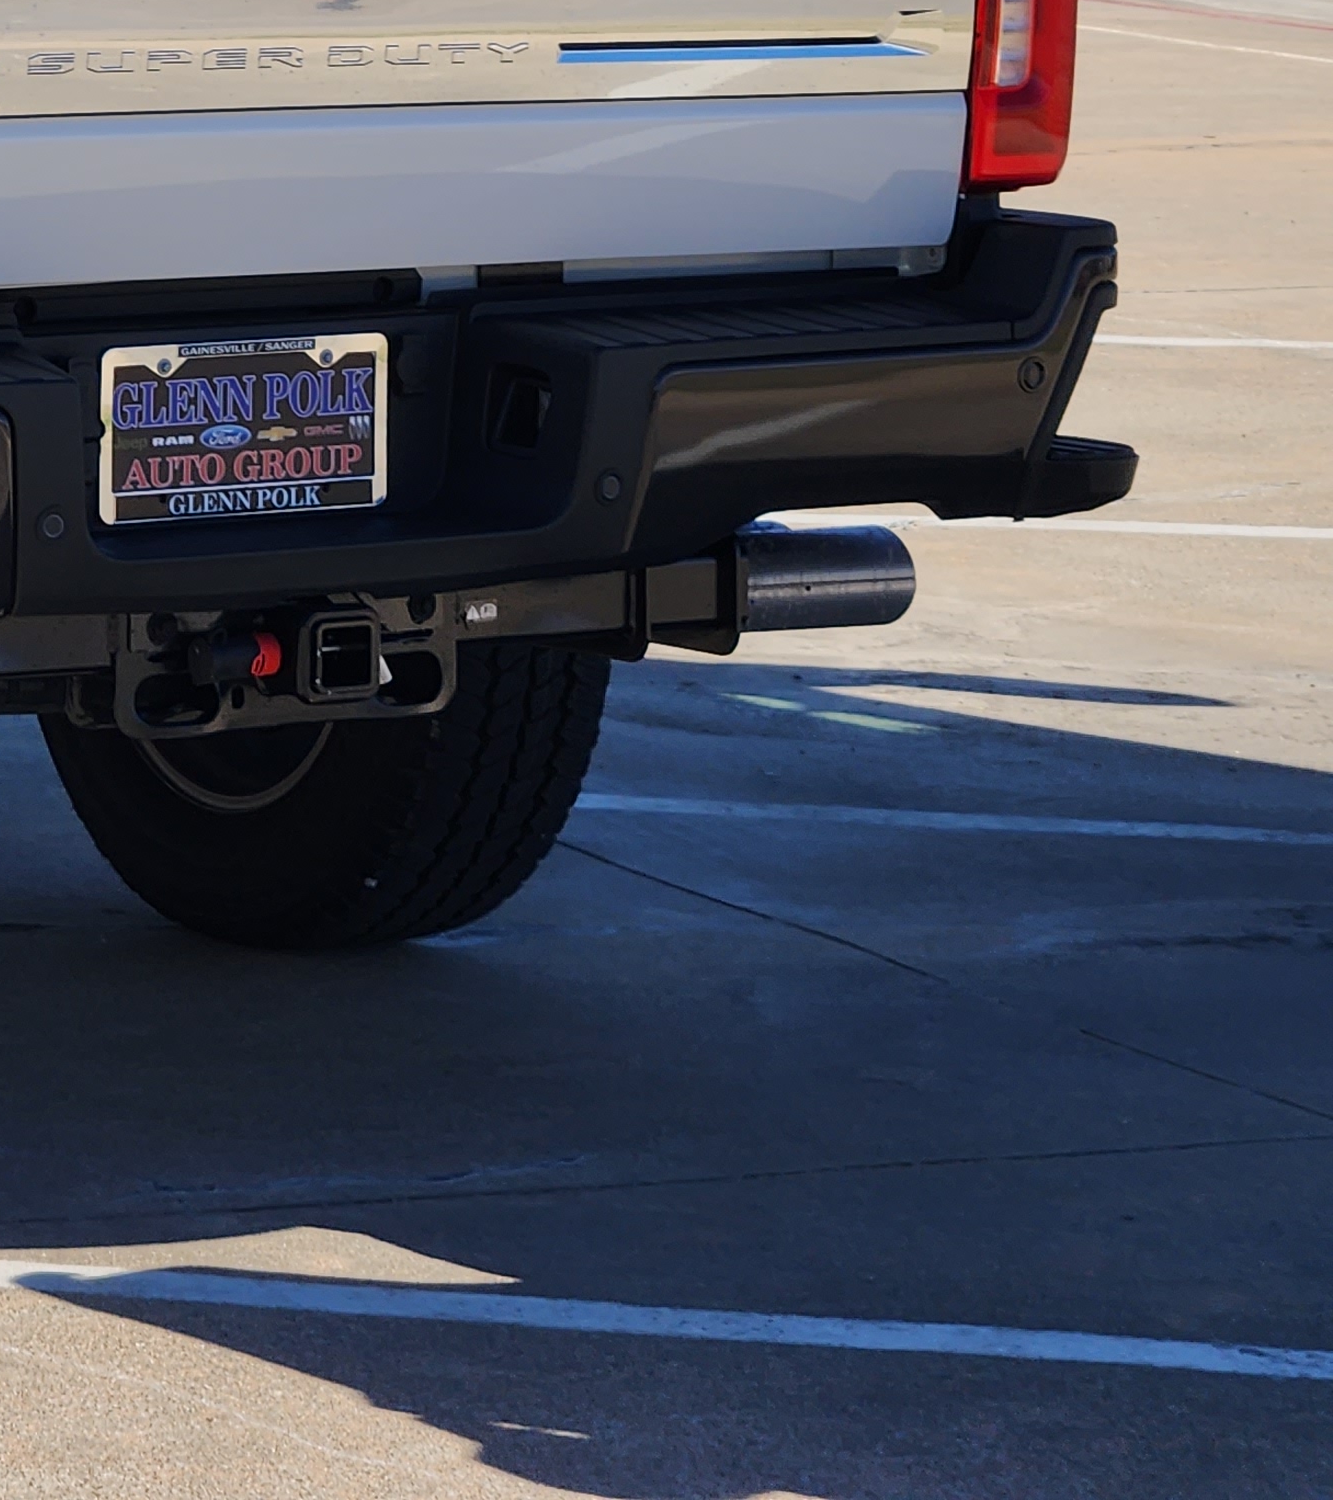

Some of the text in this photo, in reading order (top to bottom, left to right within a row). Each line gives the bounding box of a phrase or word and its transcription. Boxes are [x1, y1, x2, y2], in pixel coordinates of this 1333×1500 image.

[27, 42, 529, 75] SUPER DUTY
[112, 367, 374, 430] GLENN POLK
[152, 435, 194, 447] RAM
[303, 423, 344, 437] GMC
[122, 443, 363, 490] AUTO GROUP
[169, 484, 321, 516] GLENN POLK
